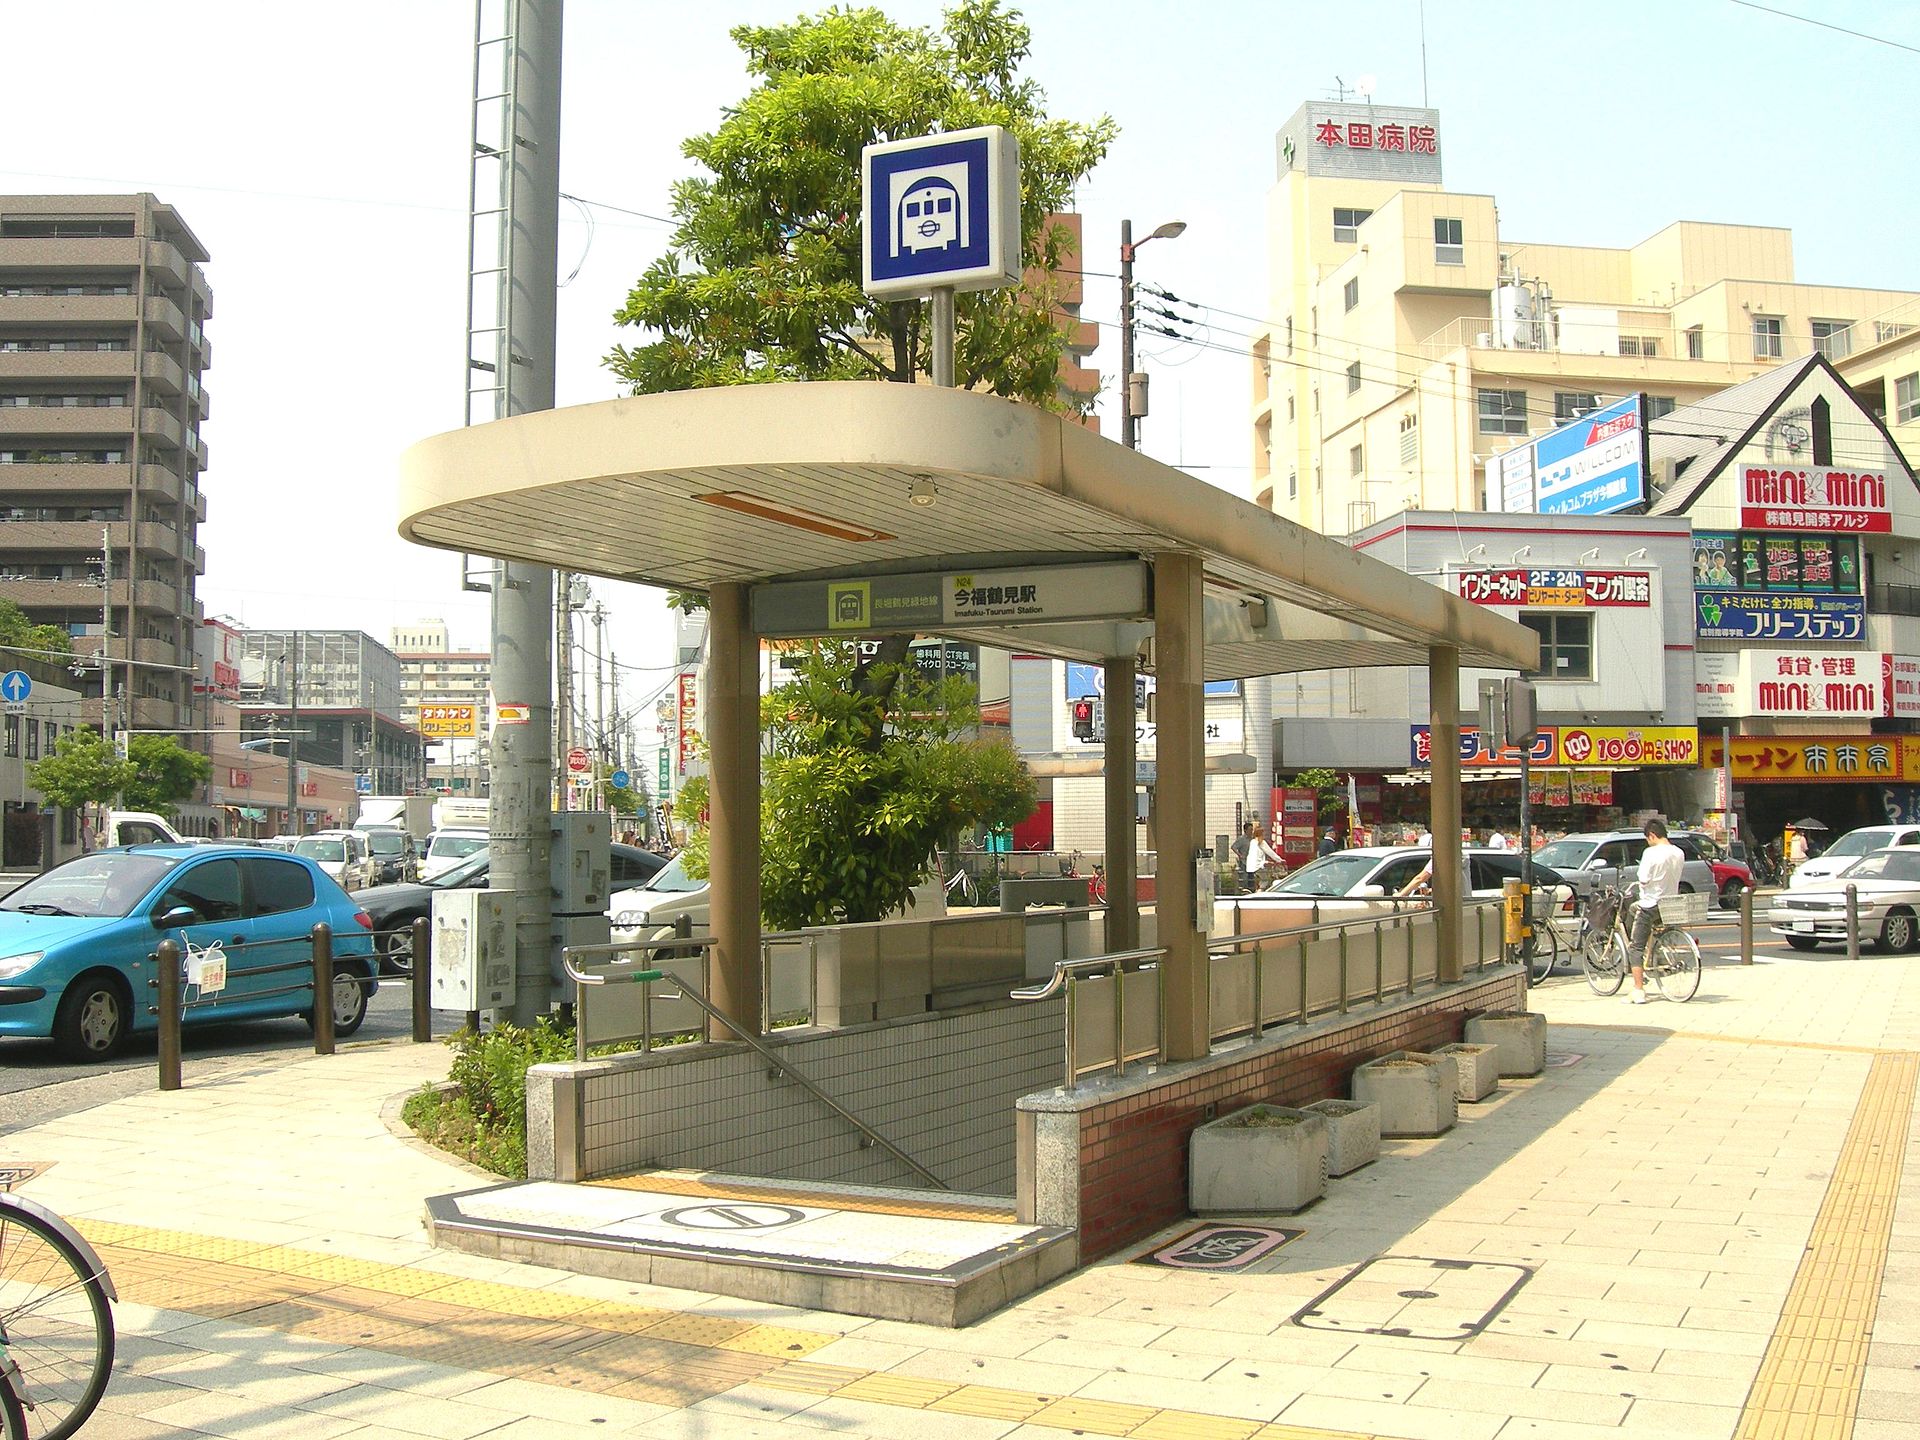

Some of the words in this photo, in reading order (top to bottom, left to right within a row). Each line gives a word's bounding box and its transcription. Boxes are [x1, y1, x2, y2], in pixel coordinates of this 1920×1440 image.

[1315, 119, 1437, 153] 本田病院
[1575, 440, 1636, 476] WILLCOM
[1745, 468, 1807, 505] mini
[1826, 471, 1886, 508] mini
[956, 577, 973, 588] N24
[1461, 573, 1527, 601] インターネット
[1586, 574, 1650, 602] マンガ喫茶
[954, 585, 1037, 607] 今福鶴見駅
[1721, 596, 1769, 609] キミだけに
[954, 608, 1016, 618] Imafuku-Tsurumi
[1017, 605, 1044, 616] Station
[1745, 612, 1863, 639] フリーステップ
[1777, 656, 1857, 677] 賃貸・管理
[1717, 683, 1735, 694] mini
[1758, 682, 1811, 711] mini
[1825, 683, 1875, 712] mini
[423, 708, 471, 719] タカケン
[424, 722, 471, 732] クリーニング
[1565, 734, 1591, 757] 100
[1663, 739, 1693, 761] SHOP
[1710, 747, 1799, 770] ラーメン
